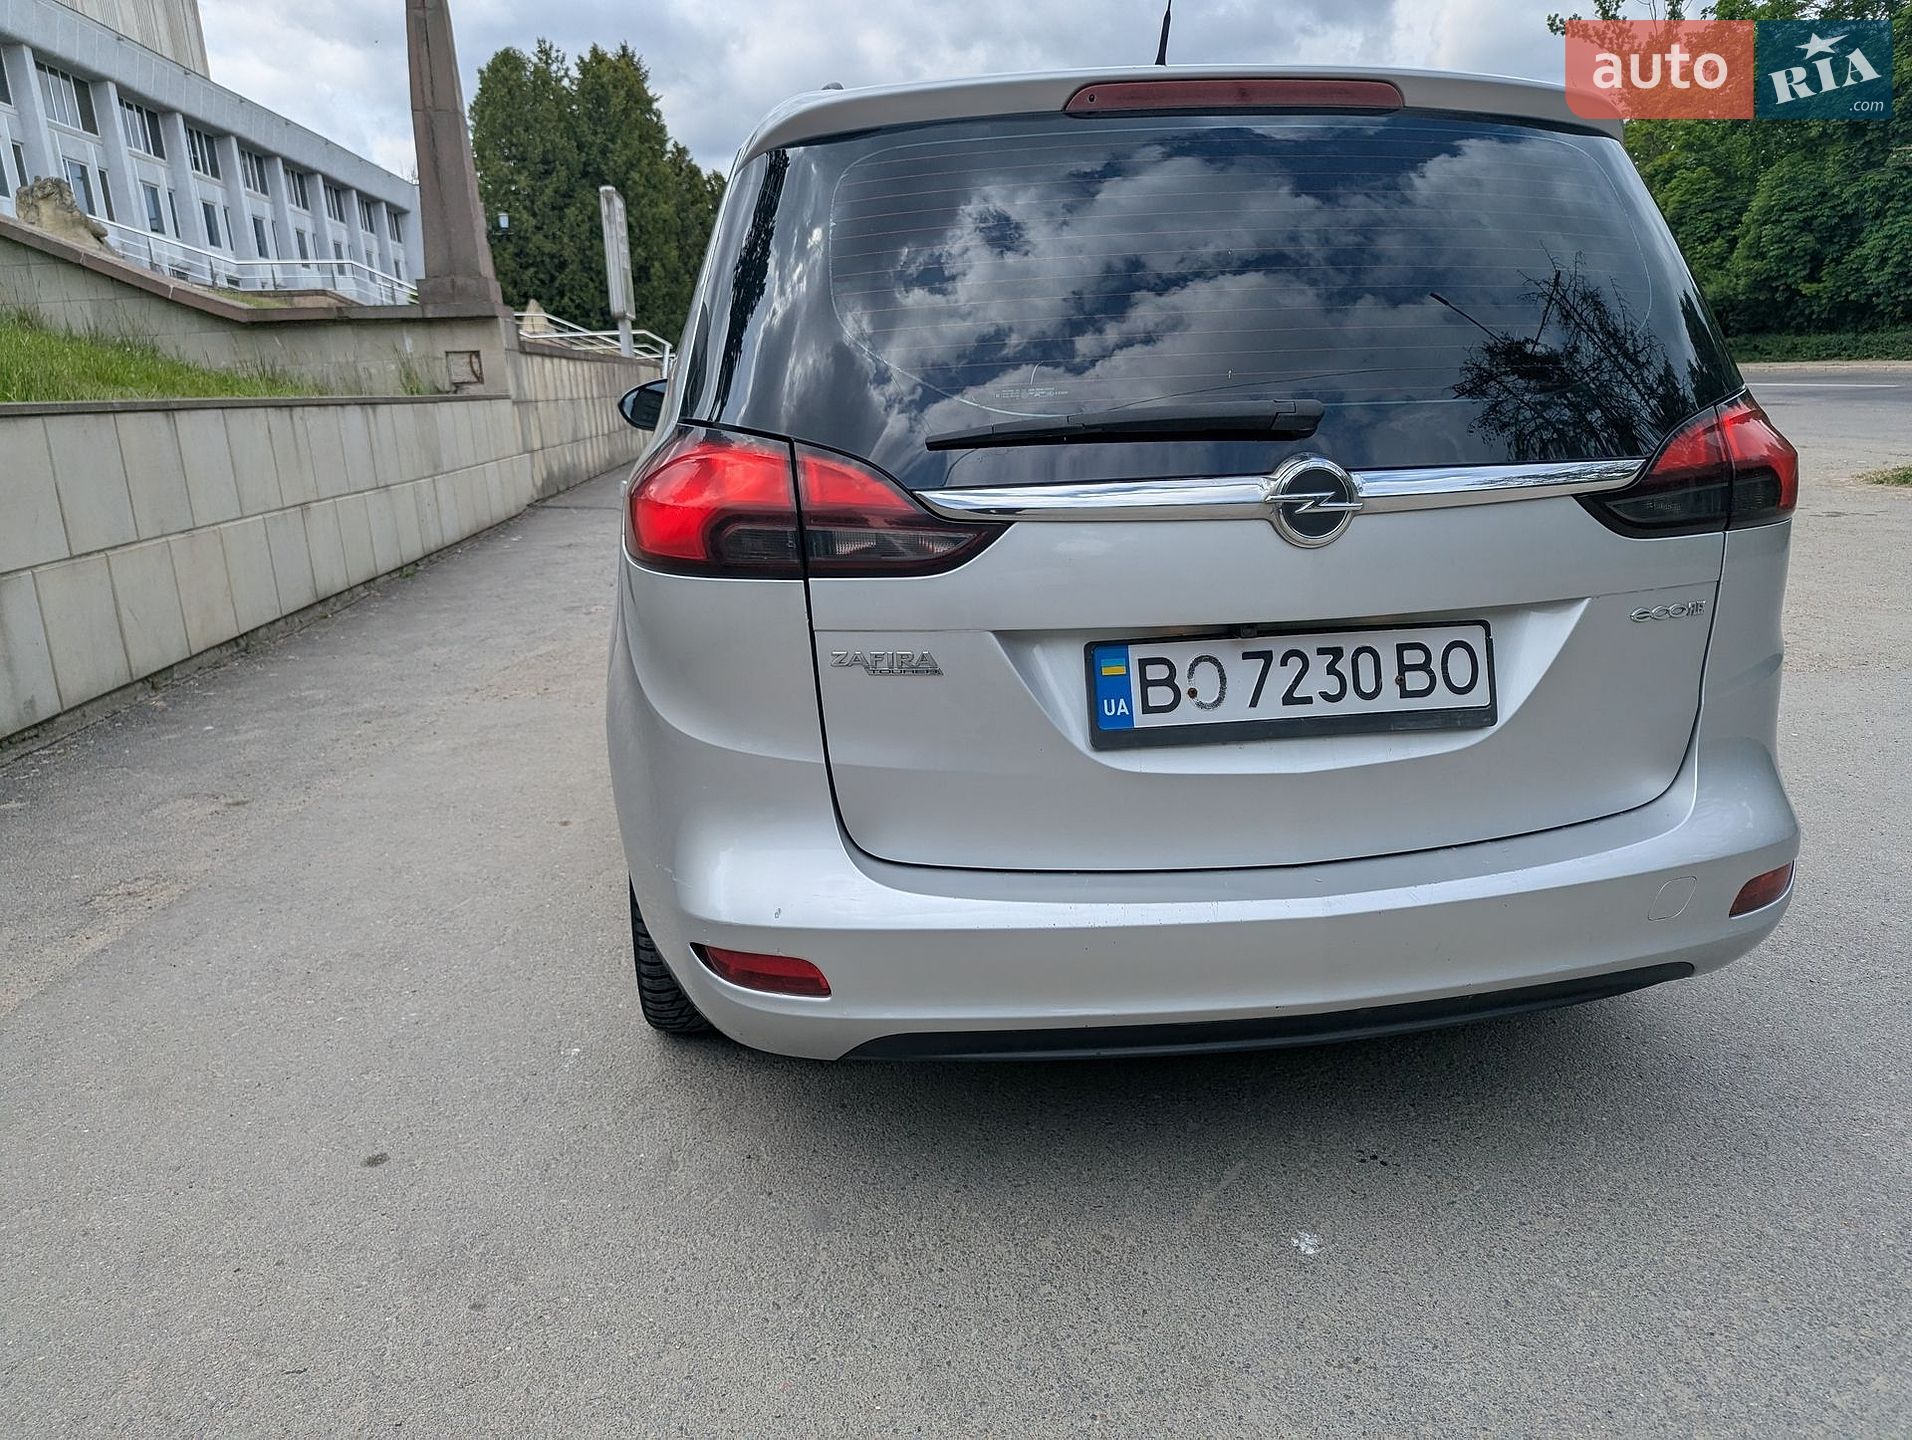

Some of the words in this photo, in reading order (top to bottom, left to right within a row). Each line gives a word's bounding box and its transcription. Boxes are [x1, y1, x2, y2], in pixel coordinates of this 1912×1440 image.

[831, 650, 939, 667] ZAFIRA
[1138, 654, 1228, 715] BO
[1241, 645, 1383, 708] 7230
[1395, 640, 1480, 699] BO
[1103, 698, 1130, 716] UA
